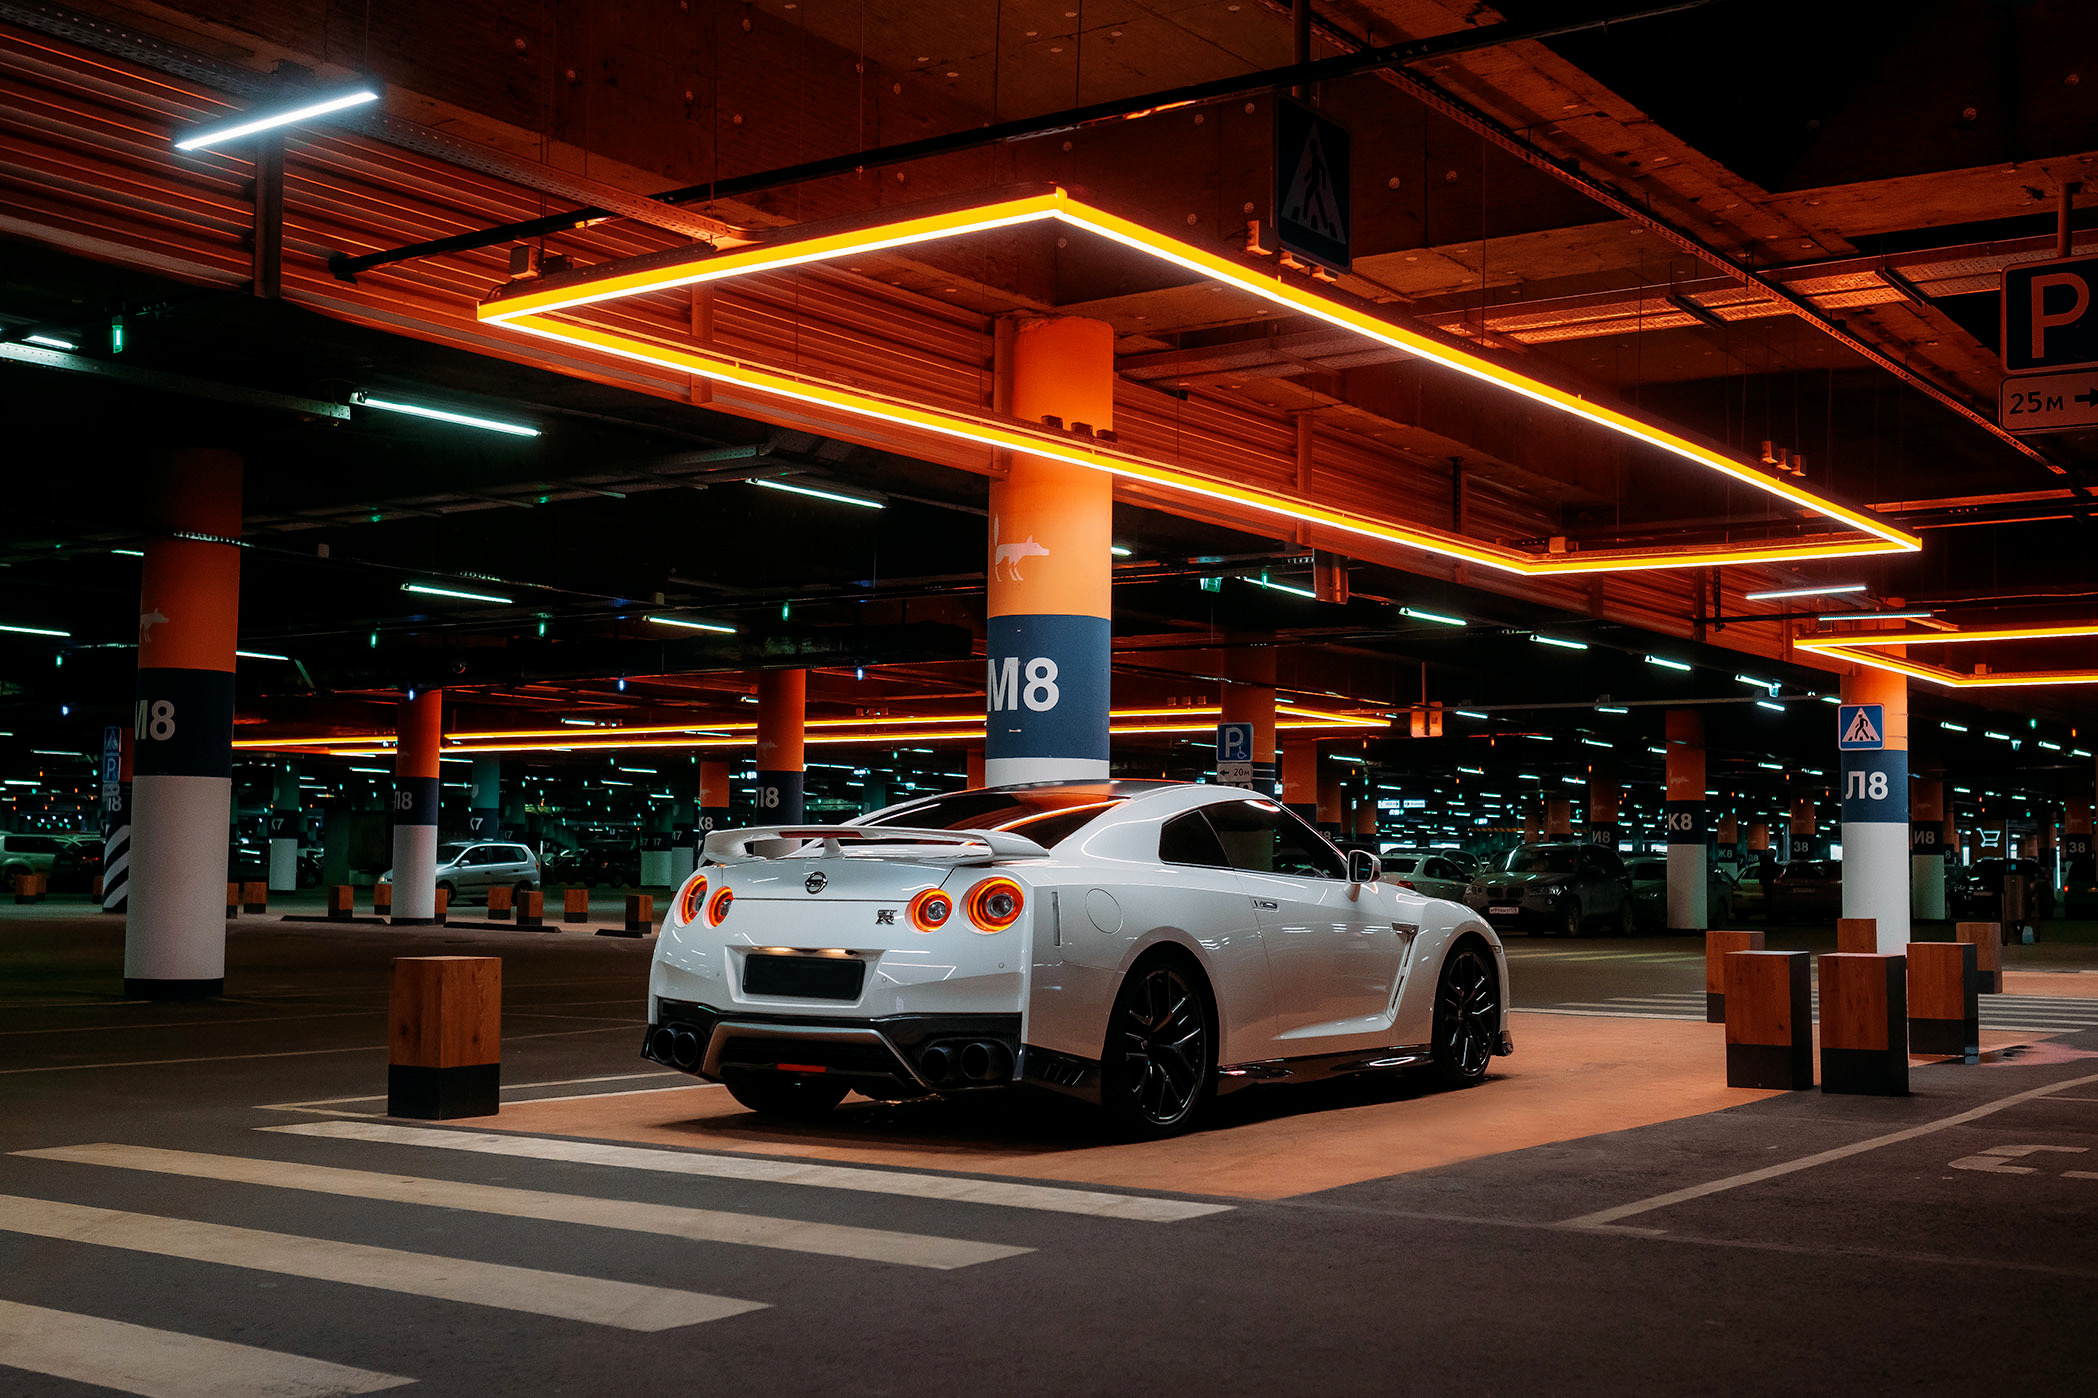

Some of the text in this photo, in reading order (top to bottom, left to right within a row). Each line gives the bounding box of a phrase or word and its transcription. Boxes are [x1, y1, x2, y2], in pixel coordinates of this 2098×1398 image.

[2031, 272, 2090, 359] P
[987, 657, 1060, 712] М8
[1225, 727, 1244, 758] P
[107, 758, 117, 779] P
[1845, 770, 1889, 800] Л8
[1667, 812, 1693, 831] К8
[1914, 830, 1936, 845] И8
